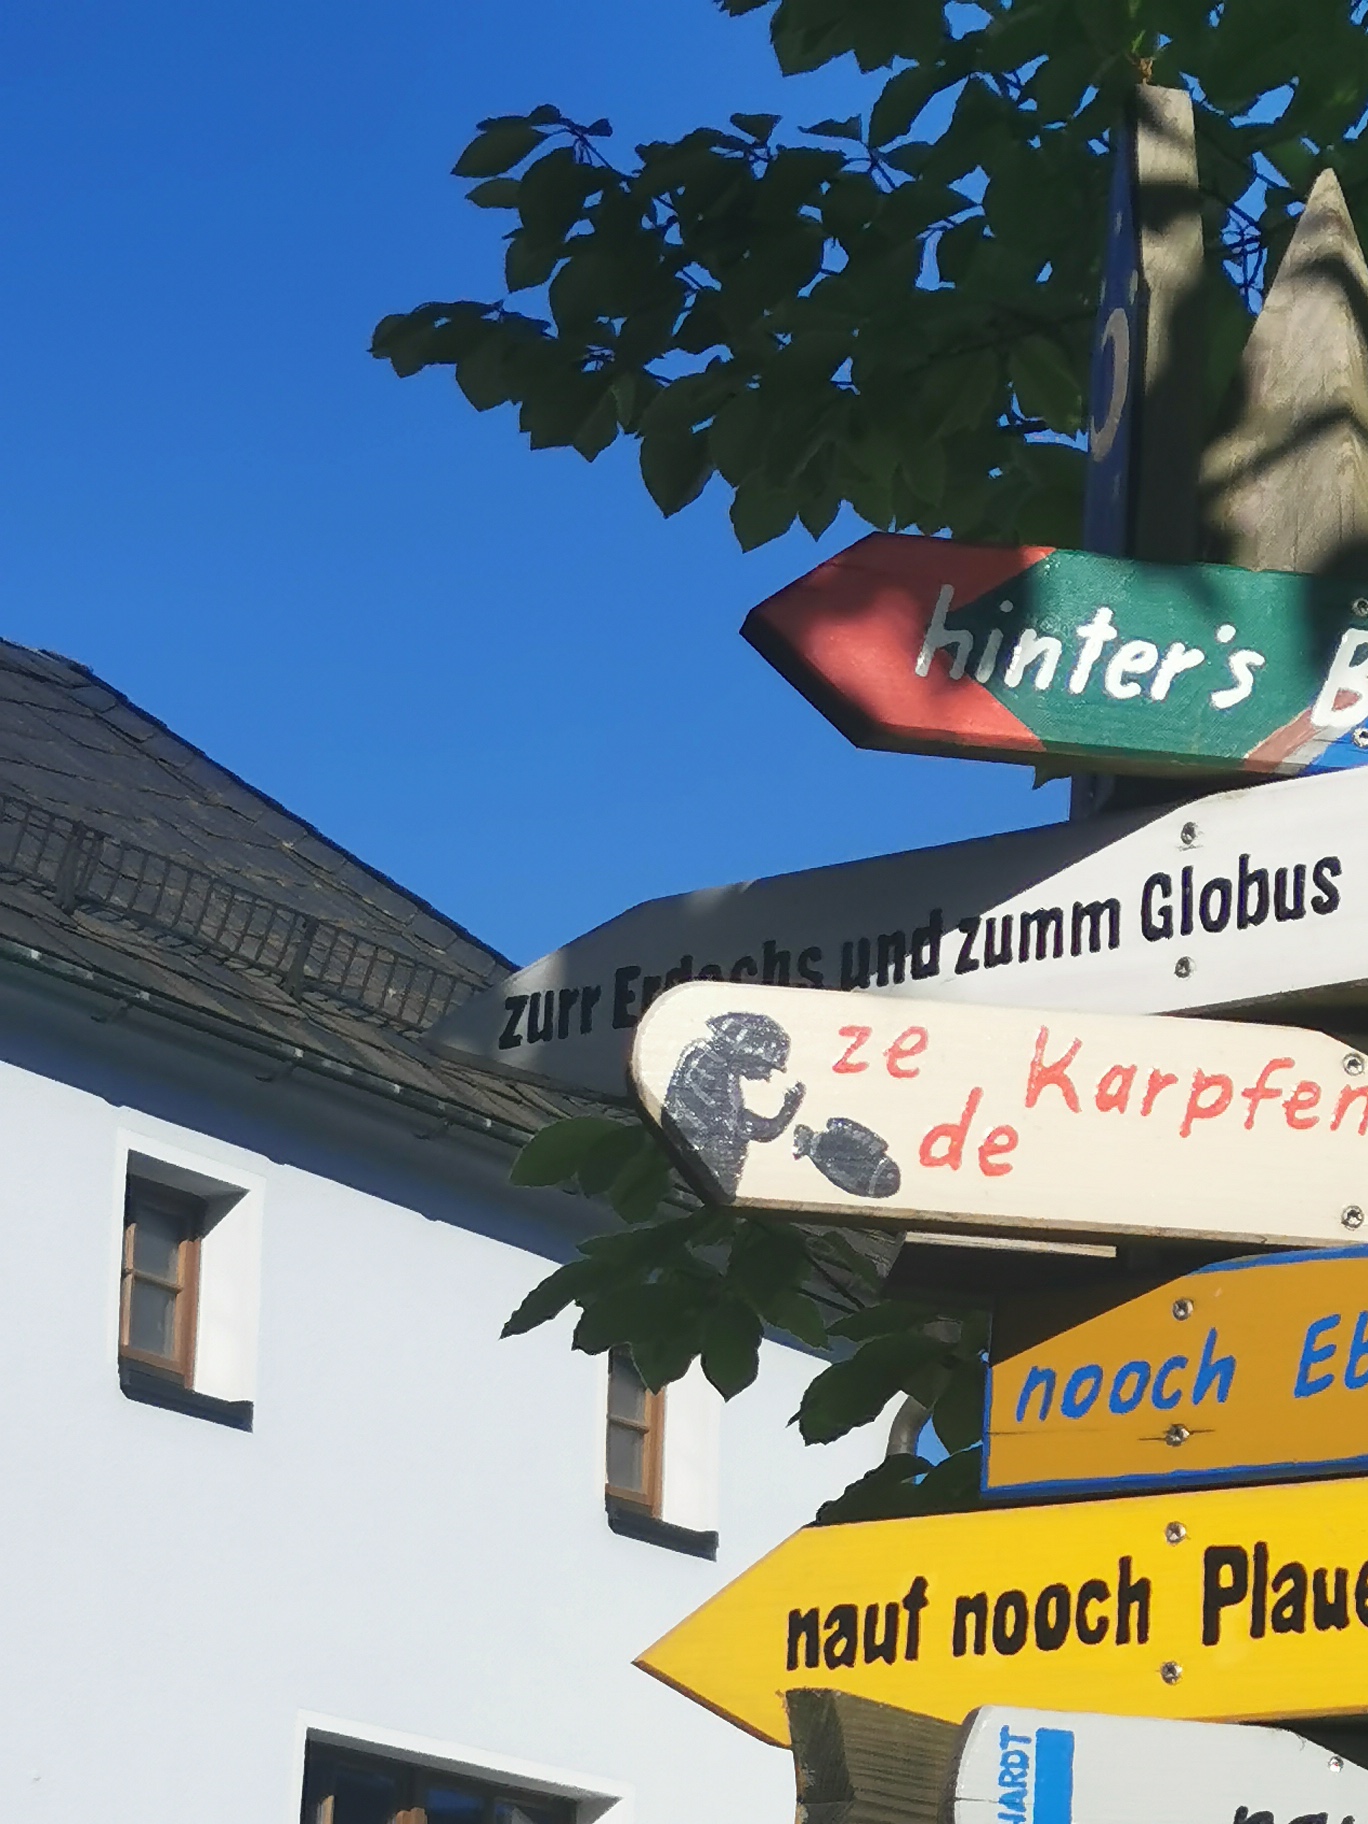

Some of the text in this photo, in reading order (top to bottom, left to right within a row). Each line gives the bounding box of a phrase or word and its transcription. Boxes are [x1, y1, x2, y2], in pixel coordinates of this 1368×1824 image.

[916, 584, 1265, 709] hinter's
[499, 981, 603, 1050] zurr
[841, 908, 943, 991] und
[955, 896, 1122, 974] zumm
[1141, 851, 1343, 943] Globus
[833, 1025, 928, 1079] ze
[920, 1087, 1019, 1177] de
[1014, 1326, 1238, 1425] nooch
[783, 1577, 930, 1676] nauf
[952, 1556, 1151, 1656] nooch
